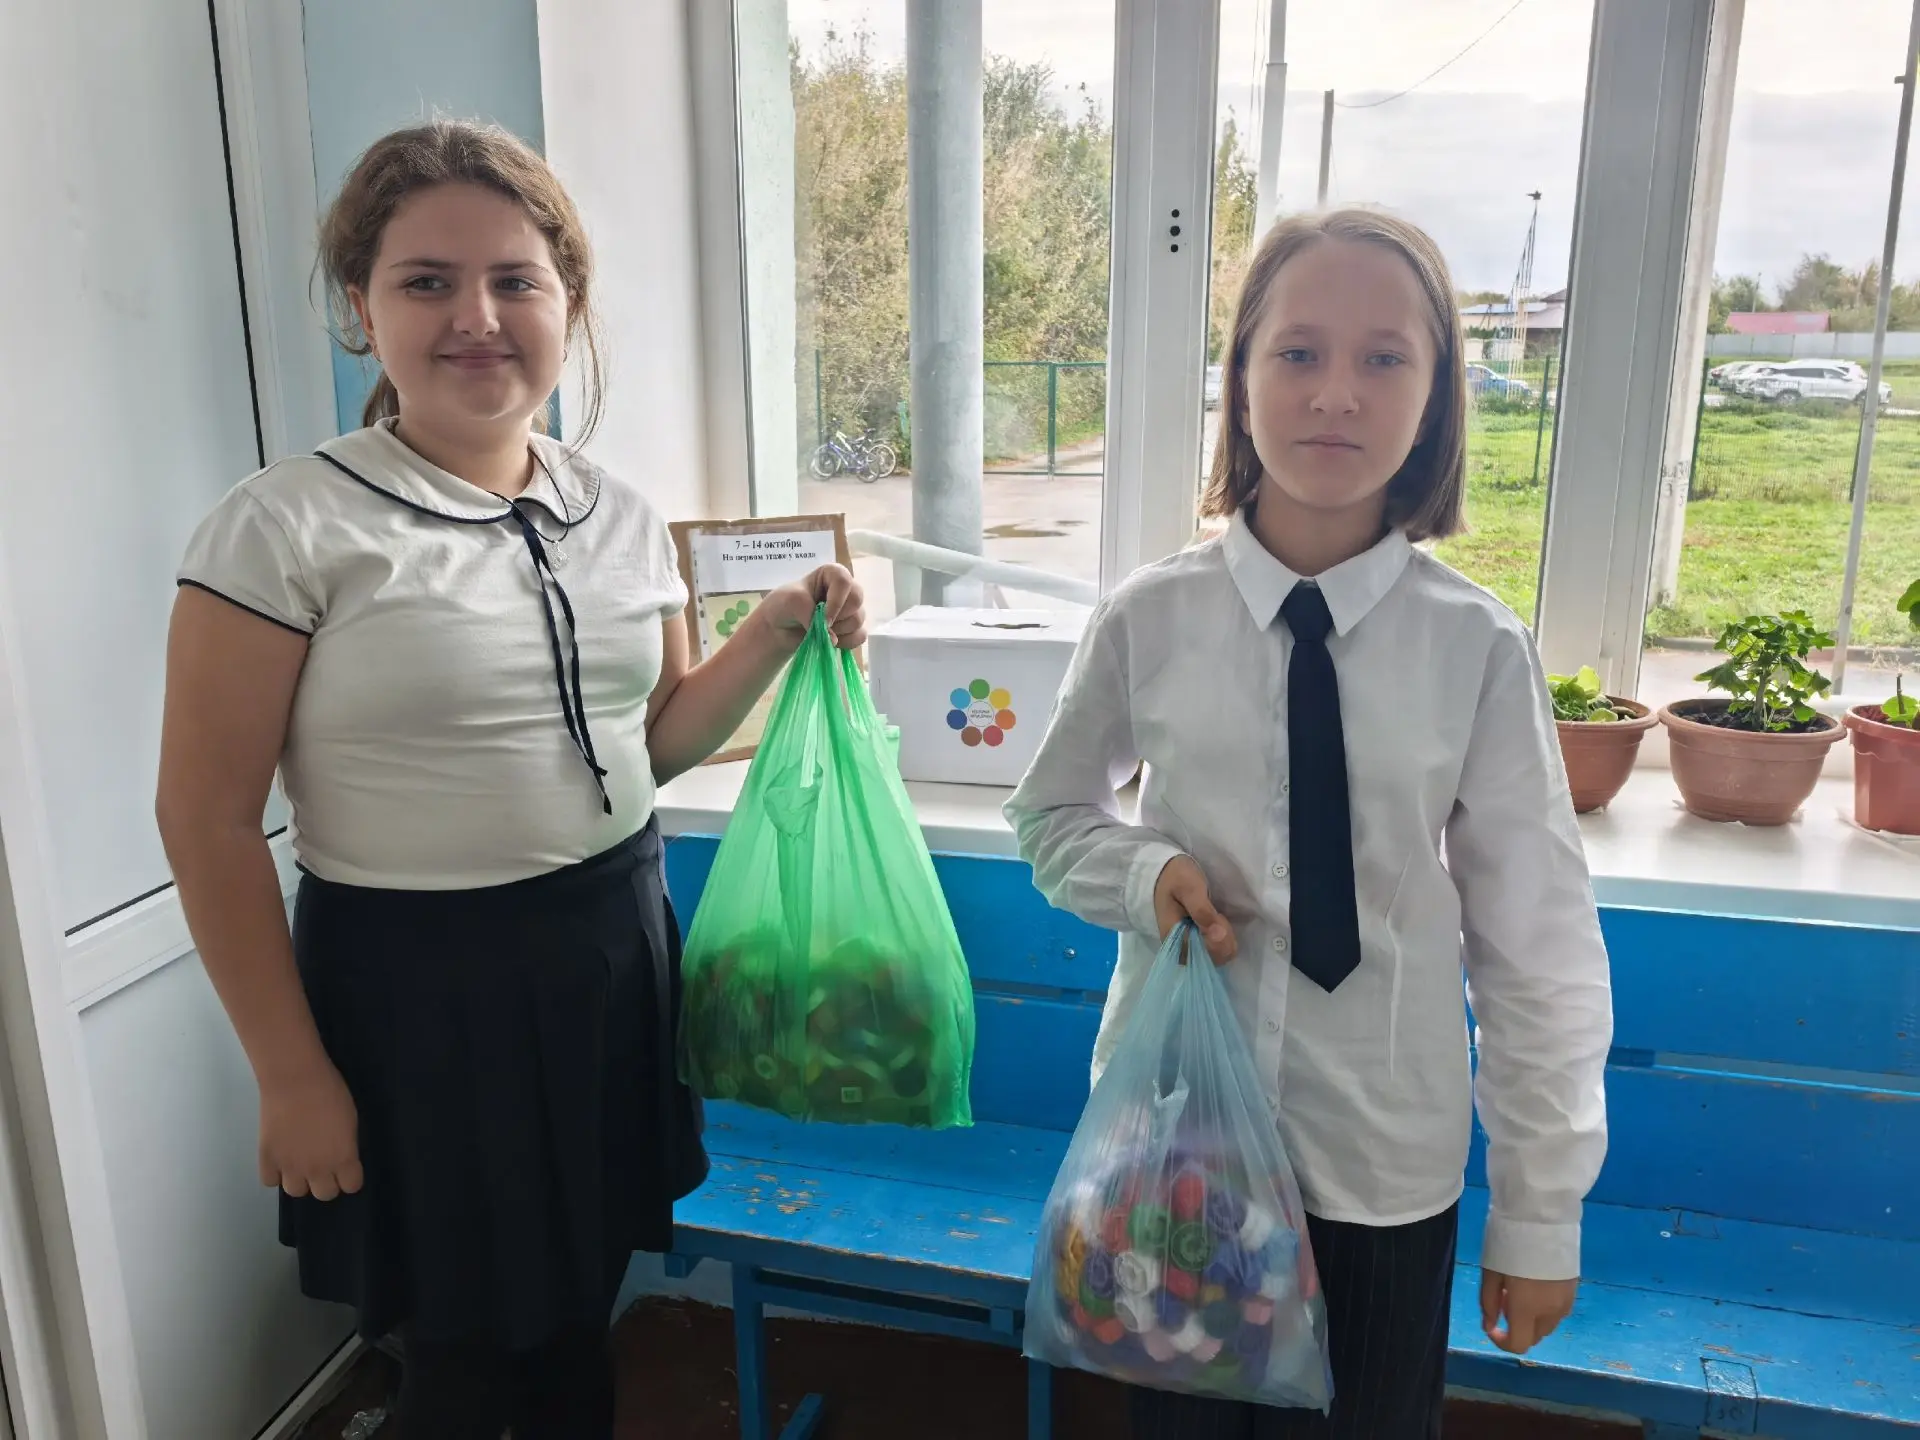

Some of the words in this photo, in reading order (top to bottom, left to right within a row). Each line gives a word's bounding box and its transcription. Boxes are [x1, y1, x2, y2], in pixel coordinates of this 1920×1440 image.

[735, 540, 741, 549] 7
[752, 540, 762, 550] 14
[764, 539, 802, 550] октября
[722, 553, 734, 561] На
